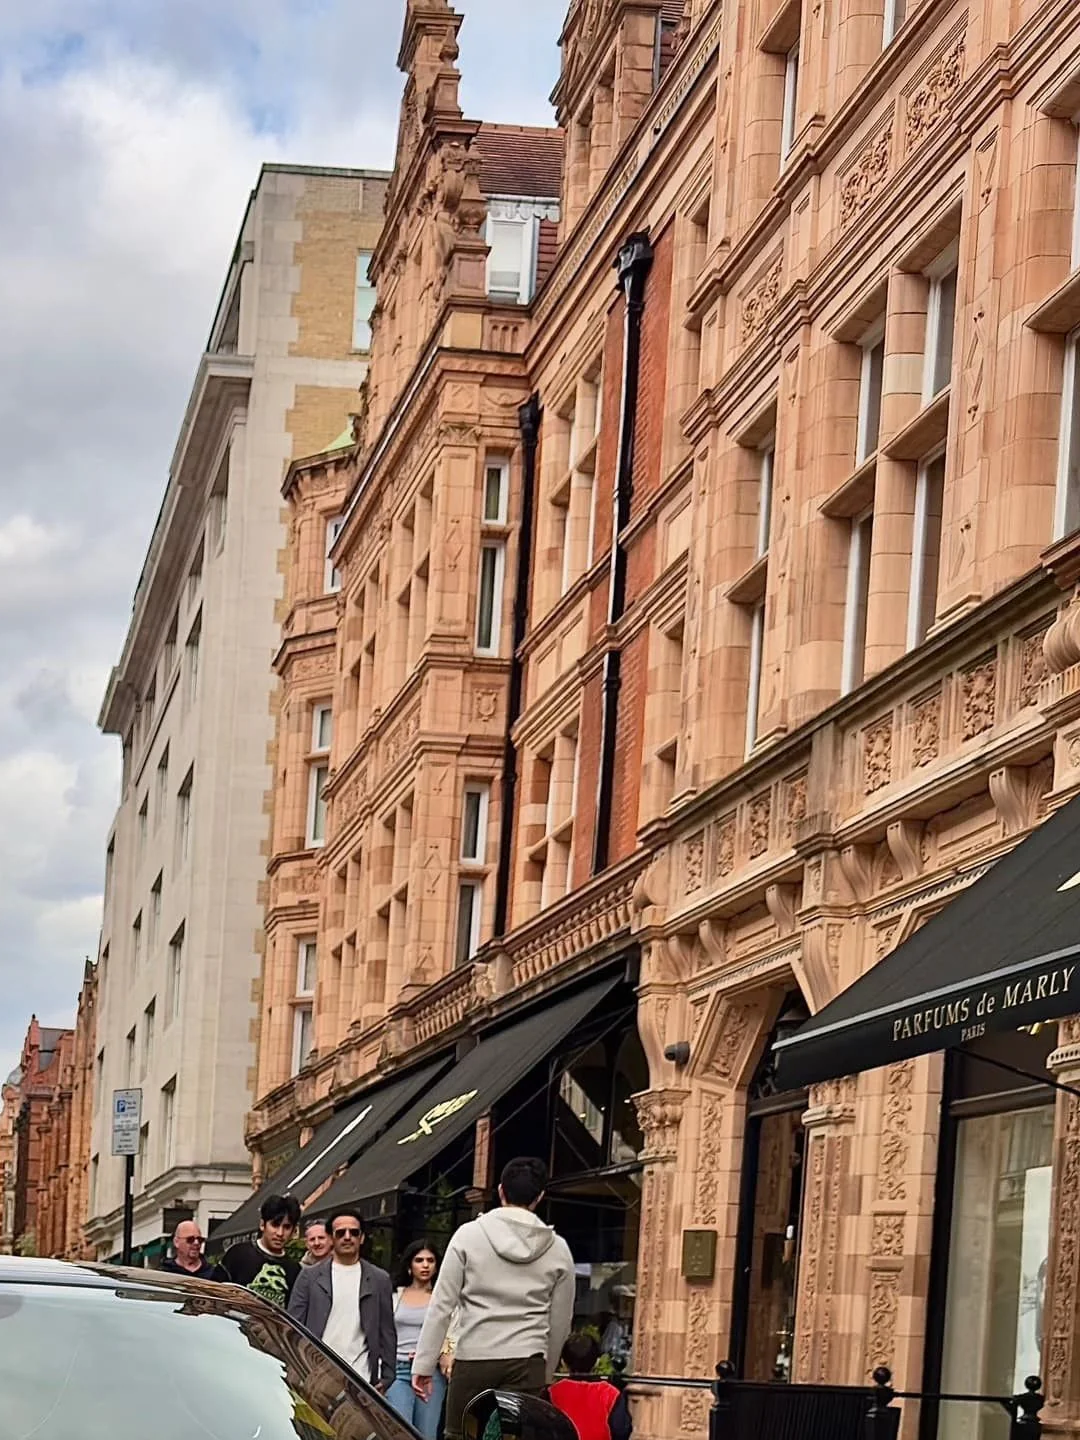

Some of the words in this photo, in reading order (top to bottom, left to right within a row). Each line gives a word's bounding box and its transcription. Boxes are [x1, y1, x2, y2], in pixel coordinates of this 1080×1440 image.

[892, 997, 971, 1042] PARFUMS
[975, 991, 996, 1017] de
[1002, 965, 1076, 1010] MARLY
[960, 1022, 986, 1043] PARIS
